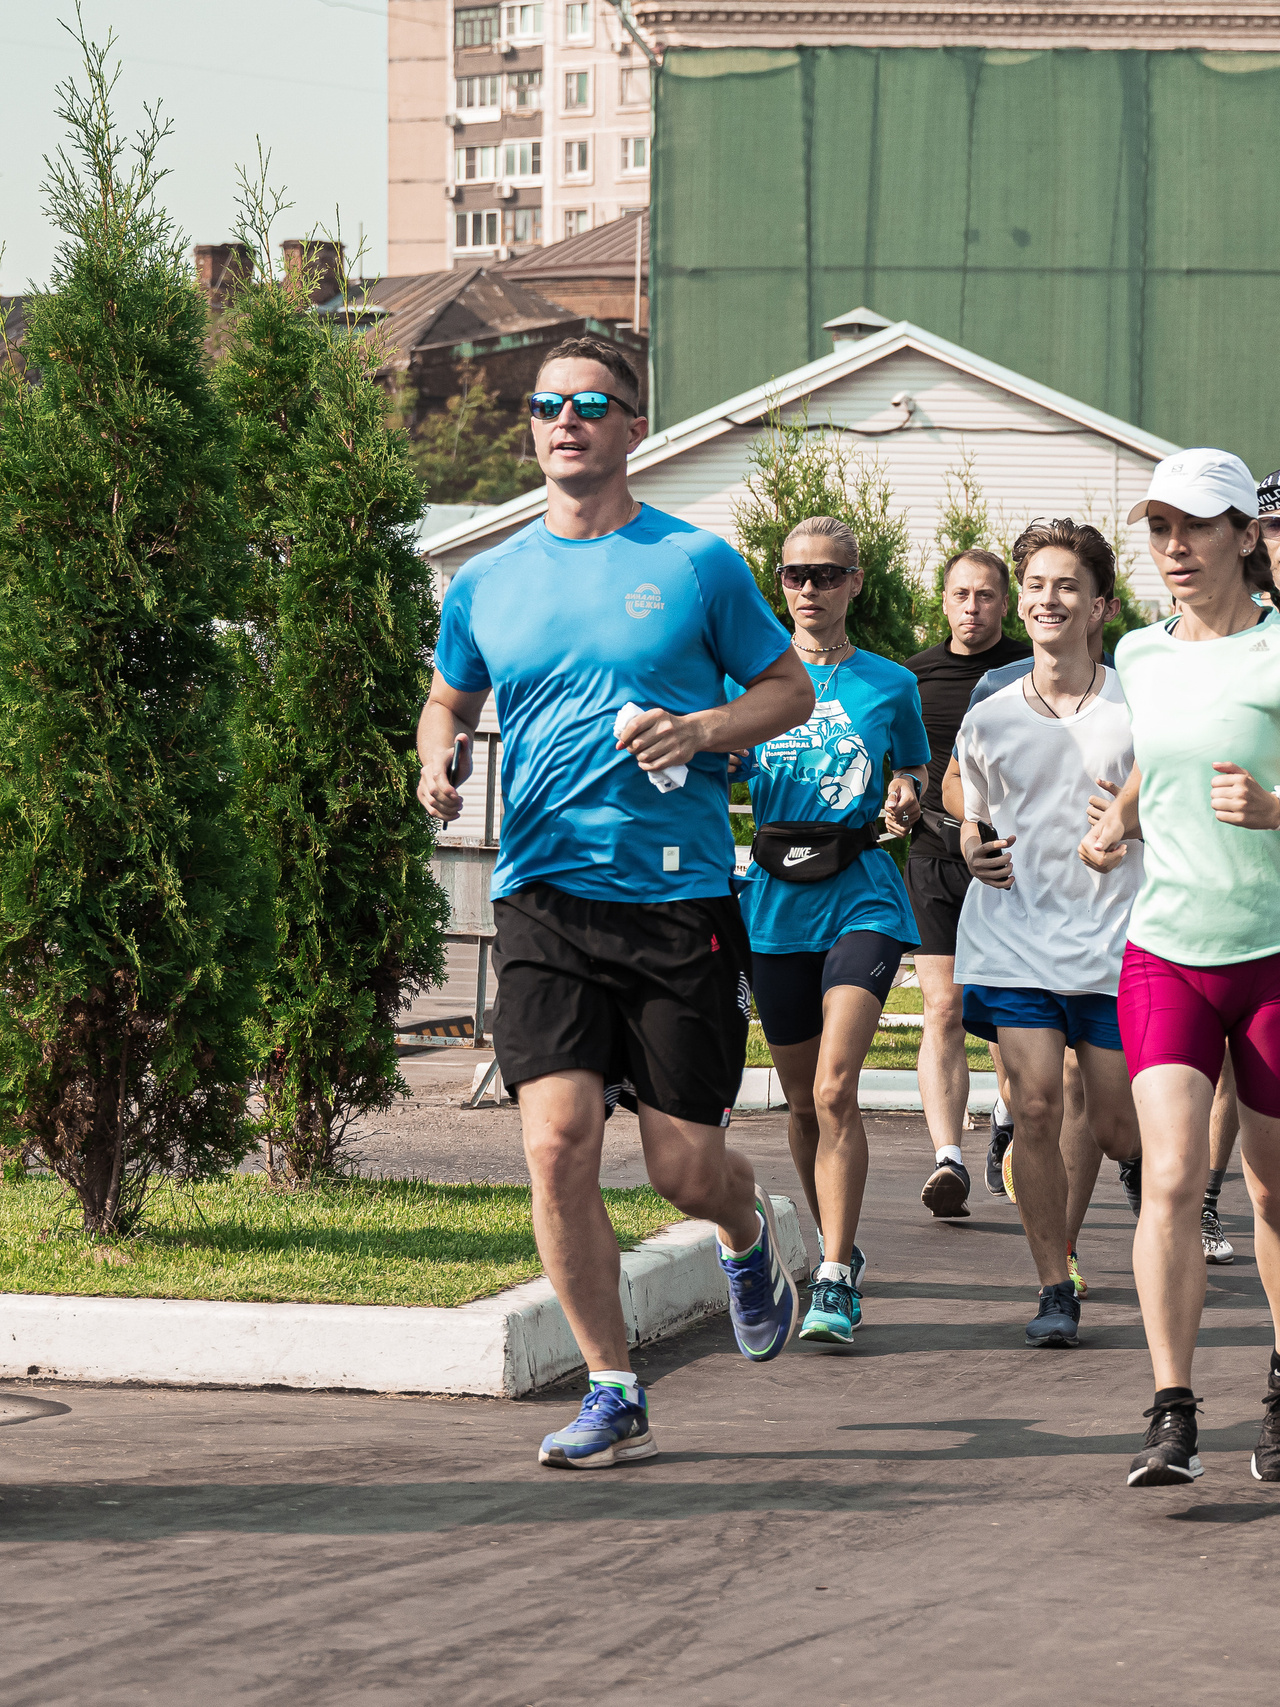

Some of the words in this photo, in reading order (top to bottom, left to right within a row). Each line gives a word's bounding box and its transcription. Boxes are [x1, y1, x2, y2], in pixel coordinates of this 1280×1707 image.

[624, 593, 662, 602] ДИНАМО
[634, 600, 665, 610] БЕЖИТ
[766, 749, 797, 758] Полярный
[789, 846, 812, 859] NIKE
